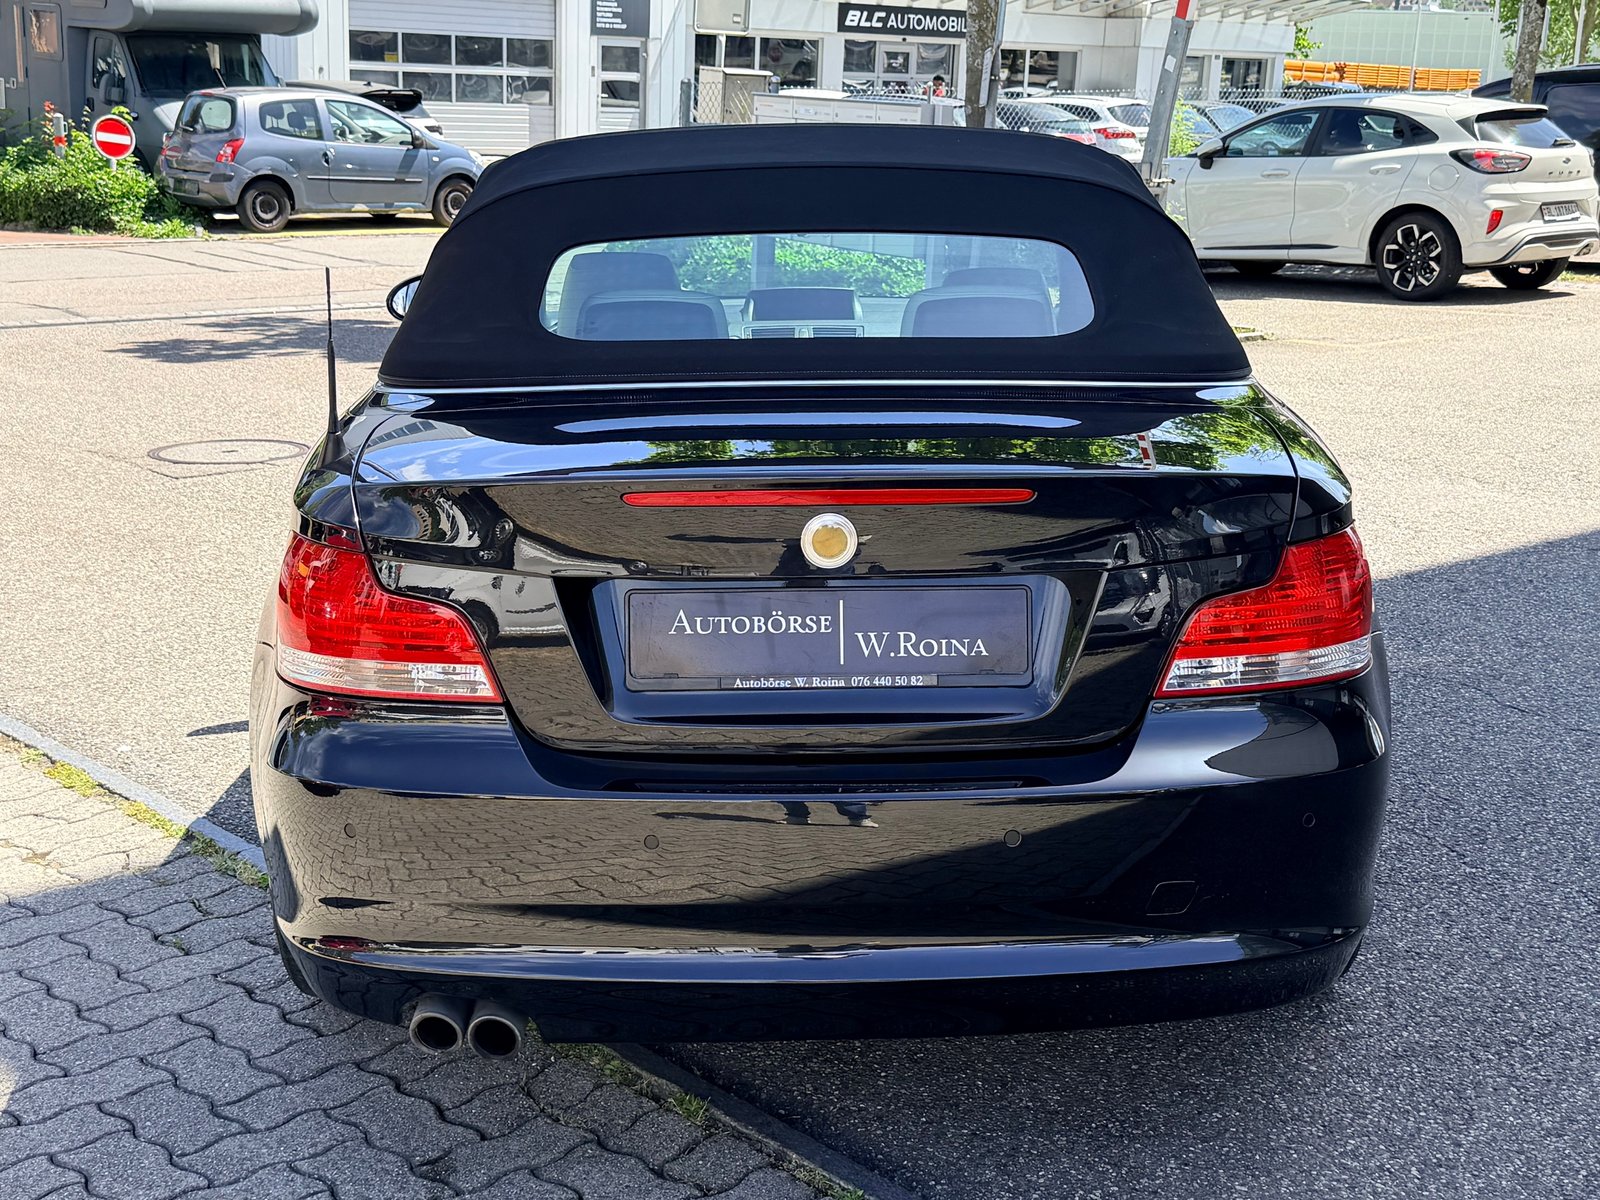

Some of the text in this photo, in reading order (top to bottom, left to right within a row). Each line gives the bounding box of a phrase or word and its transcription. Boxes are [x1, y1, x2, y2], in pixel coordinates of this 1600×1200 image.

[844, 9, 887, 28] BLC
[668, 608, 833, 635] AUTOBÖRSE
[854, 631, 989, 658] W.ROINA
[733, 675, 924, 689] Autobörse W. Roina 076 440 50 82
